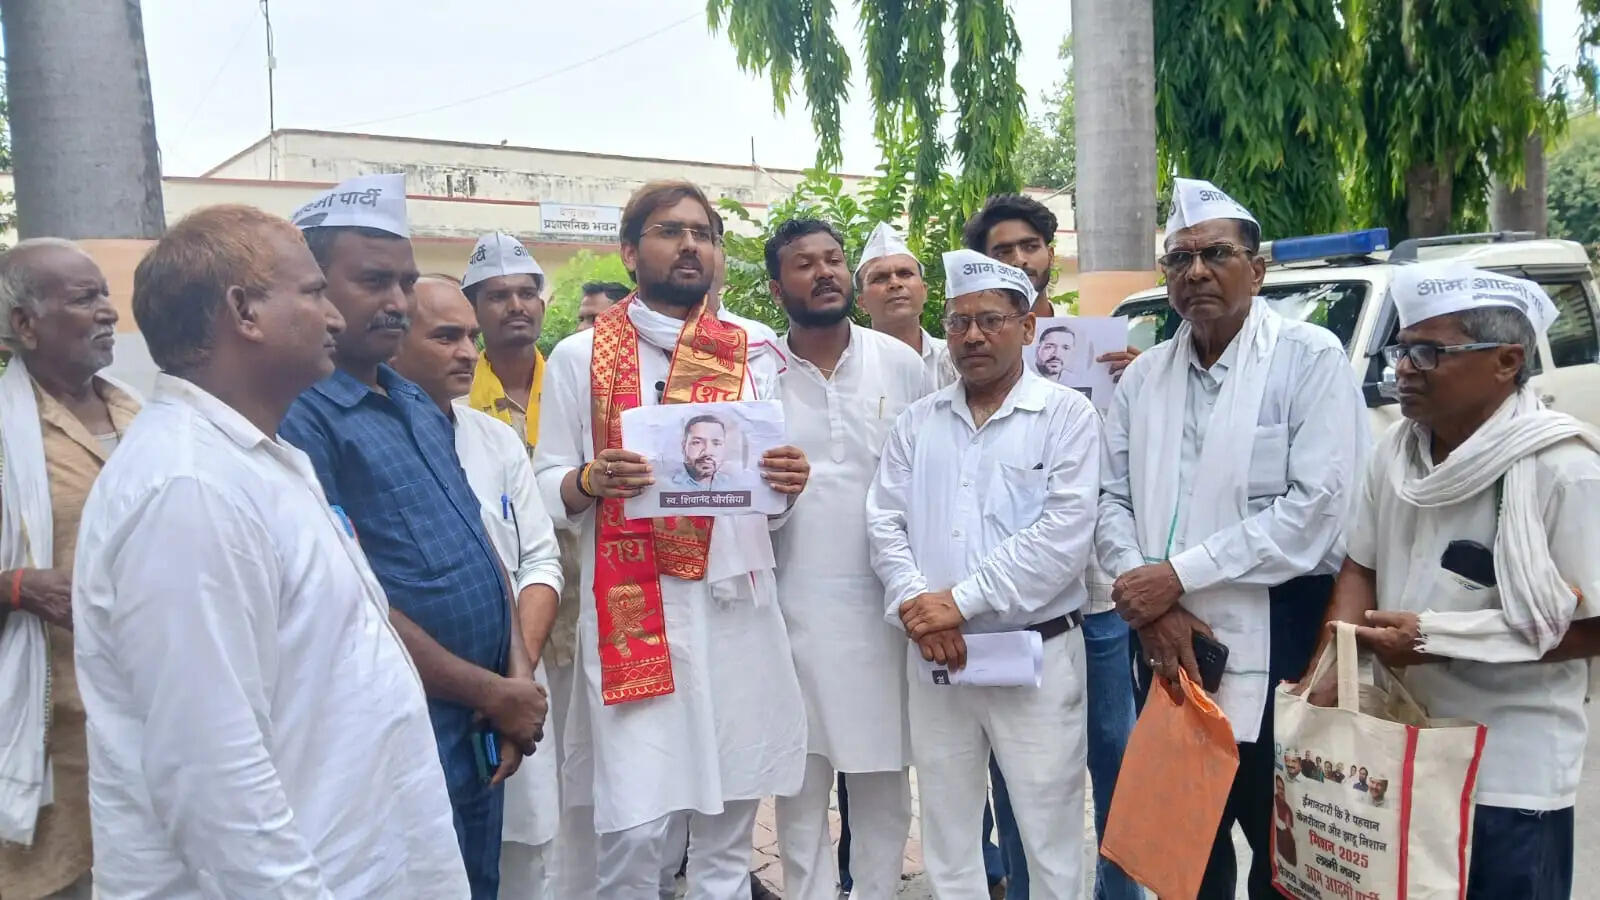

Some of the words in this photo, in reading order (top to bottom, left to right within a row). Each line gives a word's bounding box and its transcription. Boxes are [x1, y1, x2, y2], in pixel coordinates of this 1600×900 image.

[340, 188, 382, 207] पार्टी
[592, 222, 617, 231] भवन
[963, 263, 995, 275] आम
[681, 494, 710, 505] शिवानंद
[1302, 793, 1333, 816] ईमानदारी
[1353, 815, 1380, 832] पहचान
[1296, 809, 1326, 832] केजरीवाल
[1328, 822, 1341, 838] और
[1359, 833, 1387, 852] निशान
[1309, 829, 1336, 855] मिशन
[1339, 846, 1369, 869] 2025
